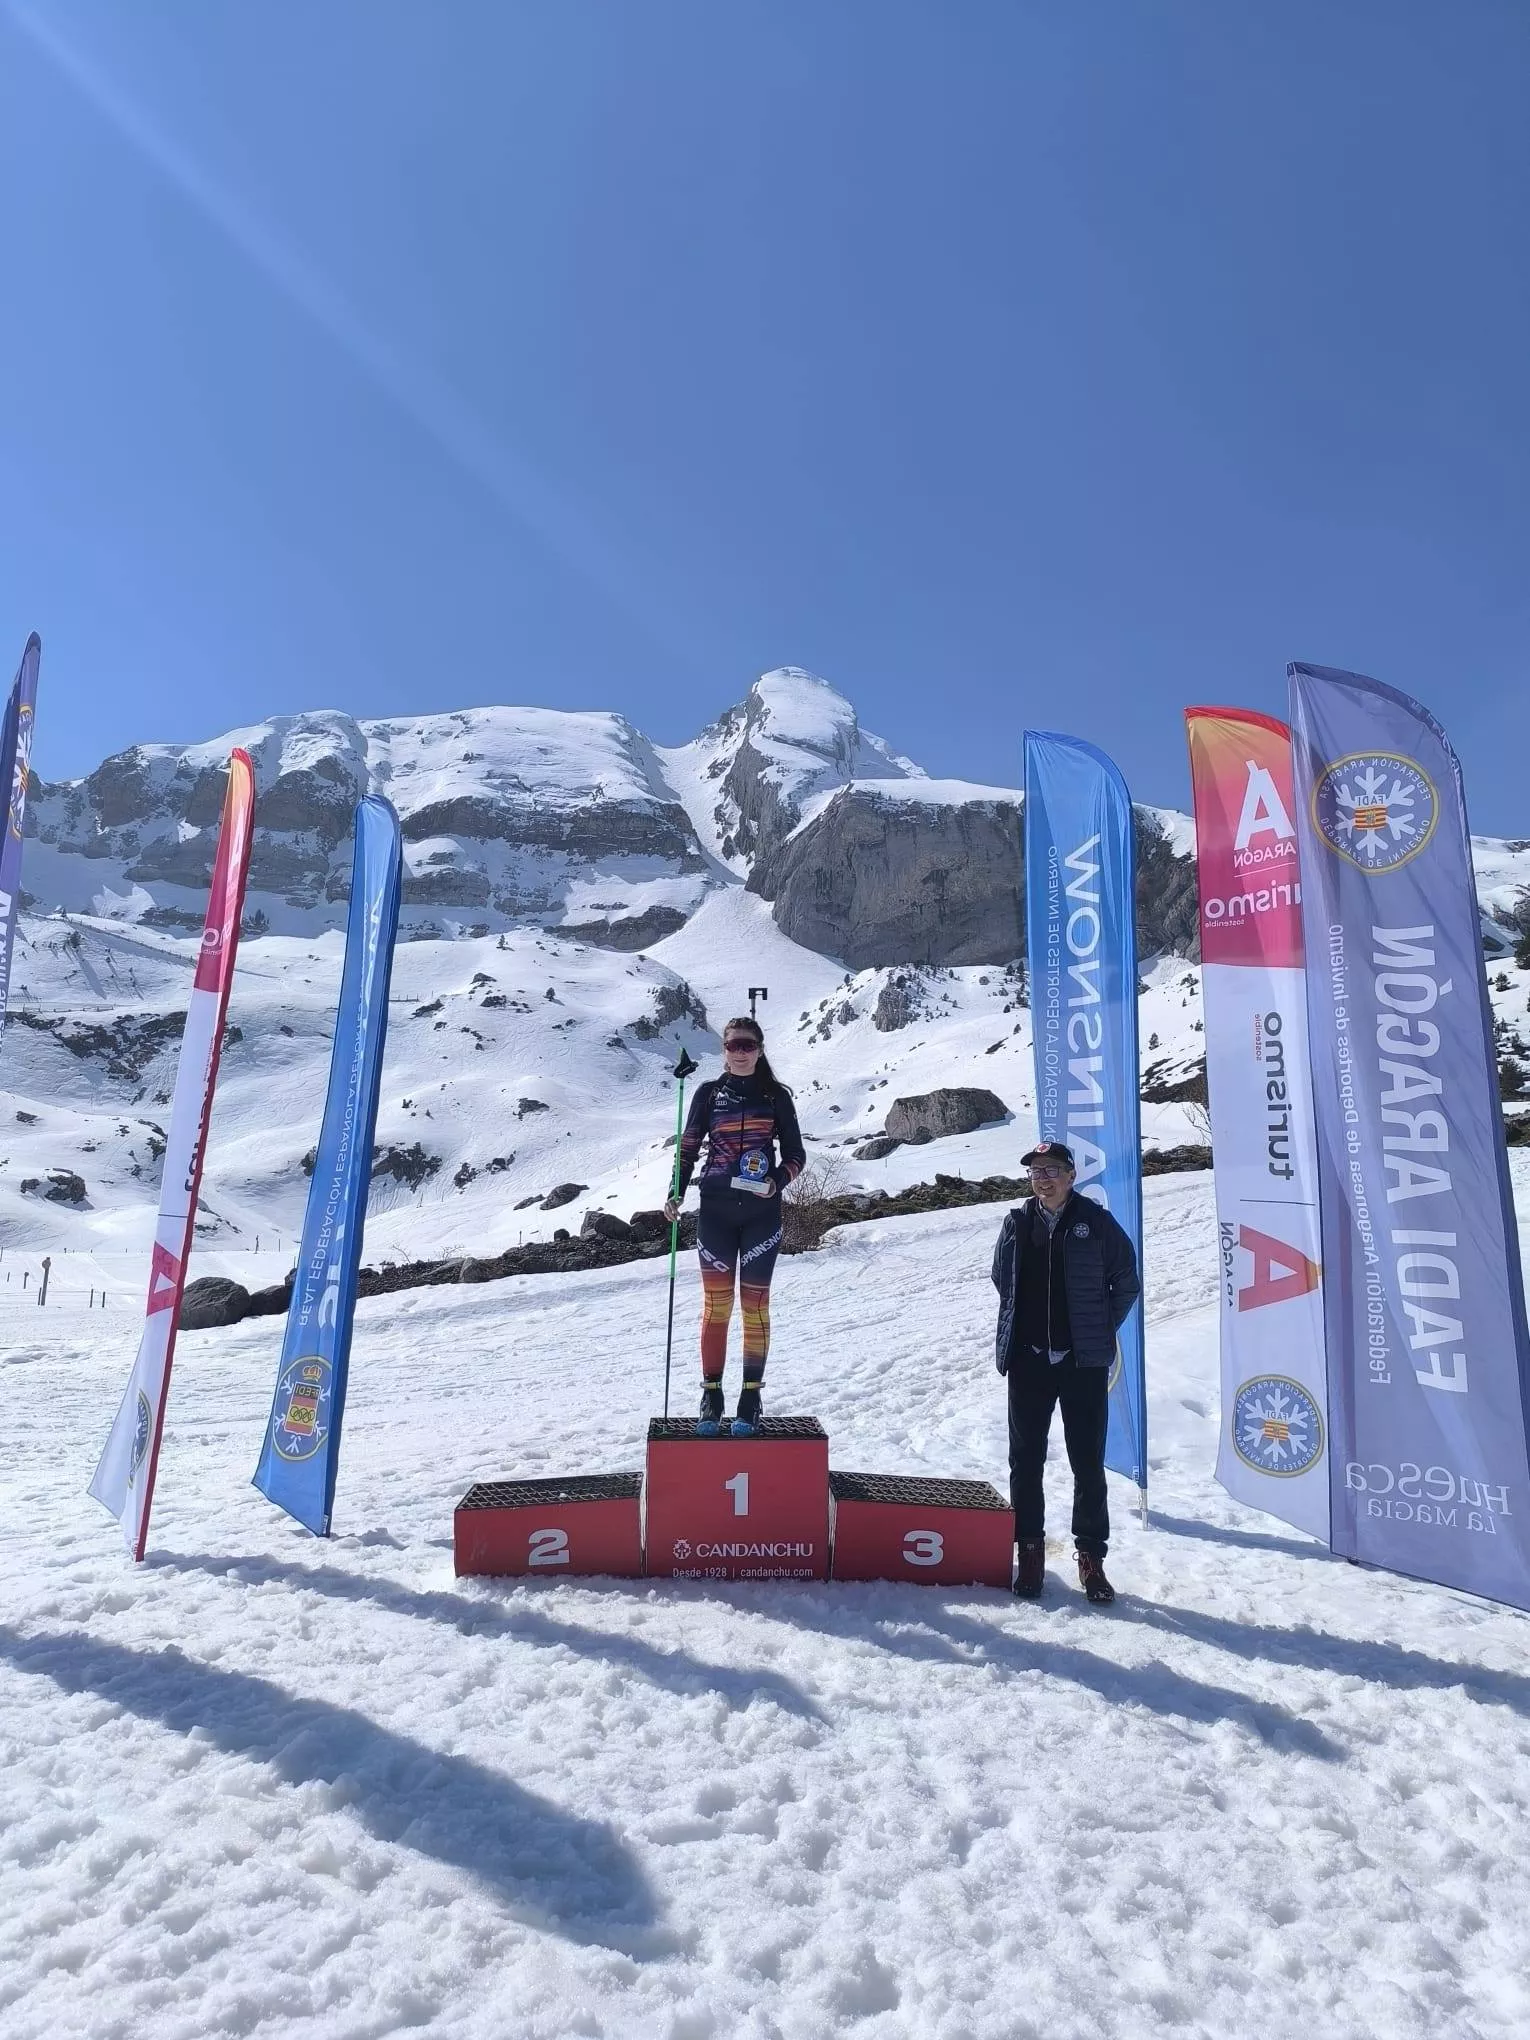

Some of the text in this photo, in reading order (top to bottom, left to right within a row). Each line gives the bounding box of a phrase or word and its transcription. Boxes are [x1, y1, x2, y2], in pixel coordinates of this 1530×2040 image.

[725, 1472, 749, 1516] 1
[528, 1528, 570, 1566] 2
[696, 1543, 813, 1557] CANDANCHU
[902, 1530, 944, 1566] 3
[672, 1567, 813, 1578] Desde 1928 candanchu.com
